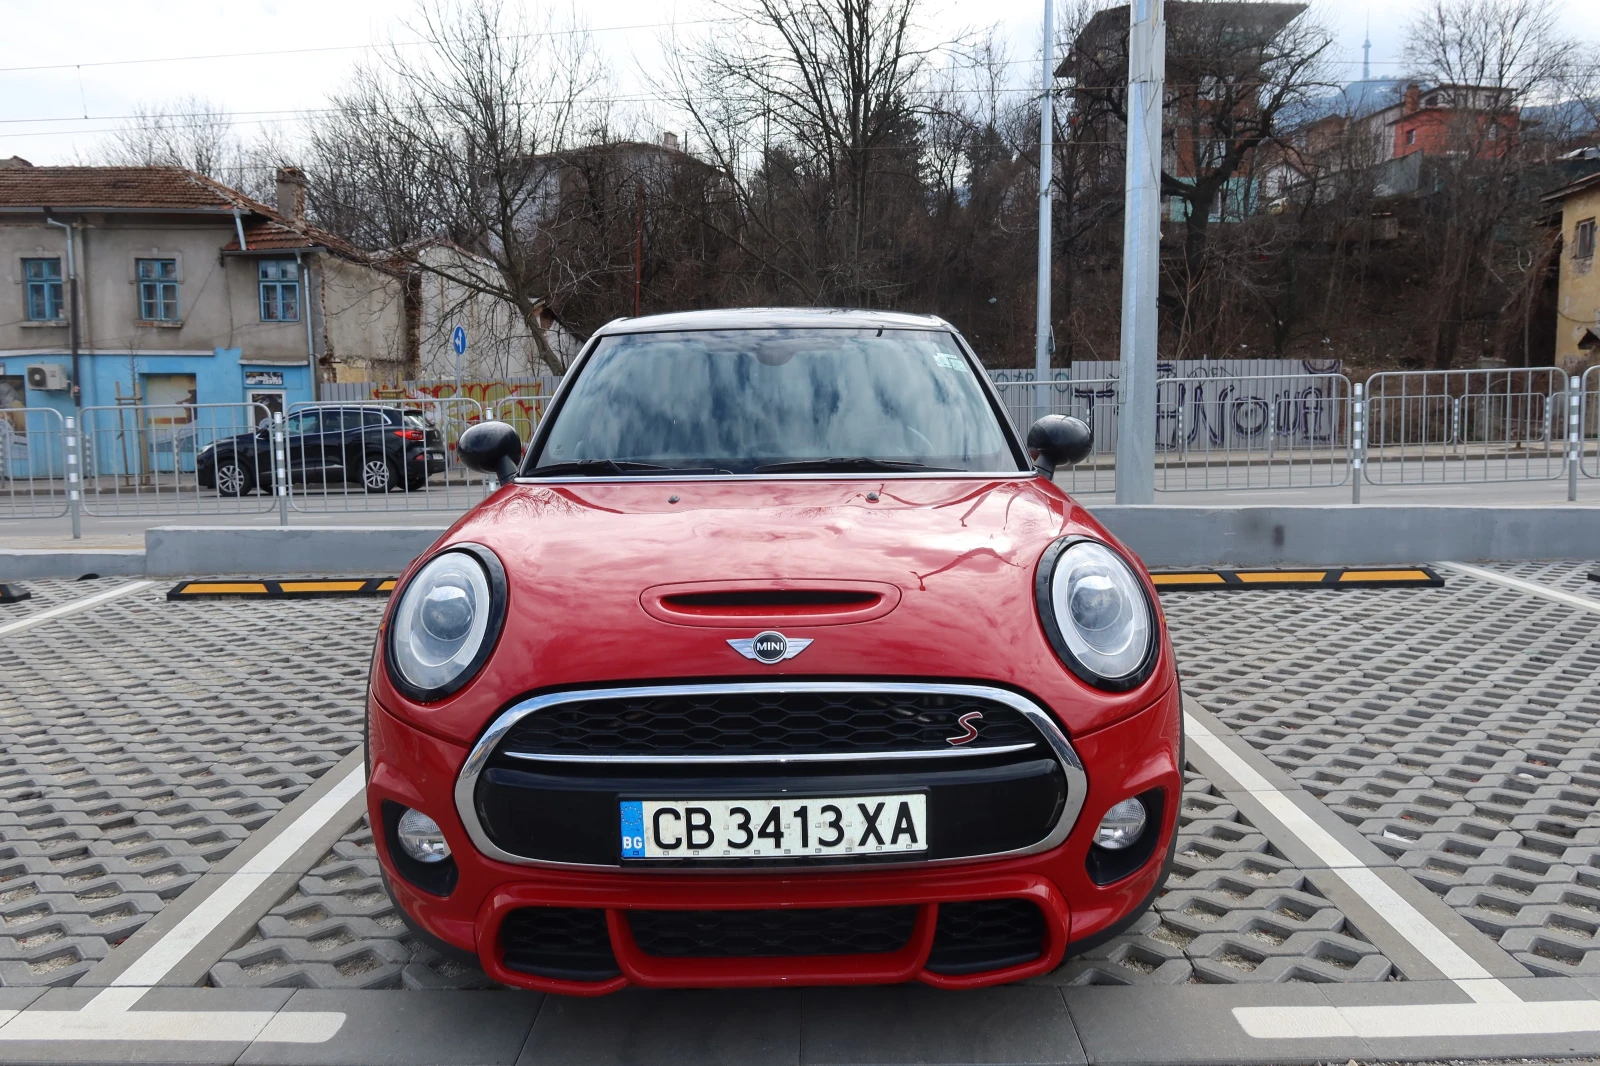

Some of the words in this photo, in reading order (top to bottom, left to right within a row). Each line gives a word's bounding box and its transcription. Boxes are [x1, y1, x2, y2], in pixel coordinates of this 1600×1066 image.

[756, 641, 784, 651] MINI
[946, 711, 983, 746] S
[652, 806, 715, 850] CB
[727, 804, 845, 850] 3413
[857, 801, 919, 847] XA
[623, 836, 643, 850] BG
